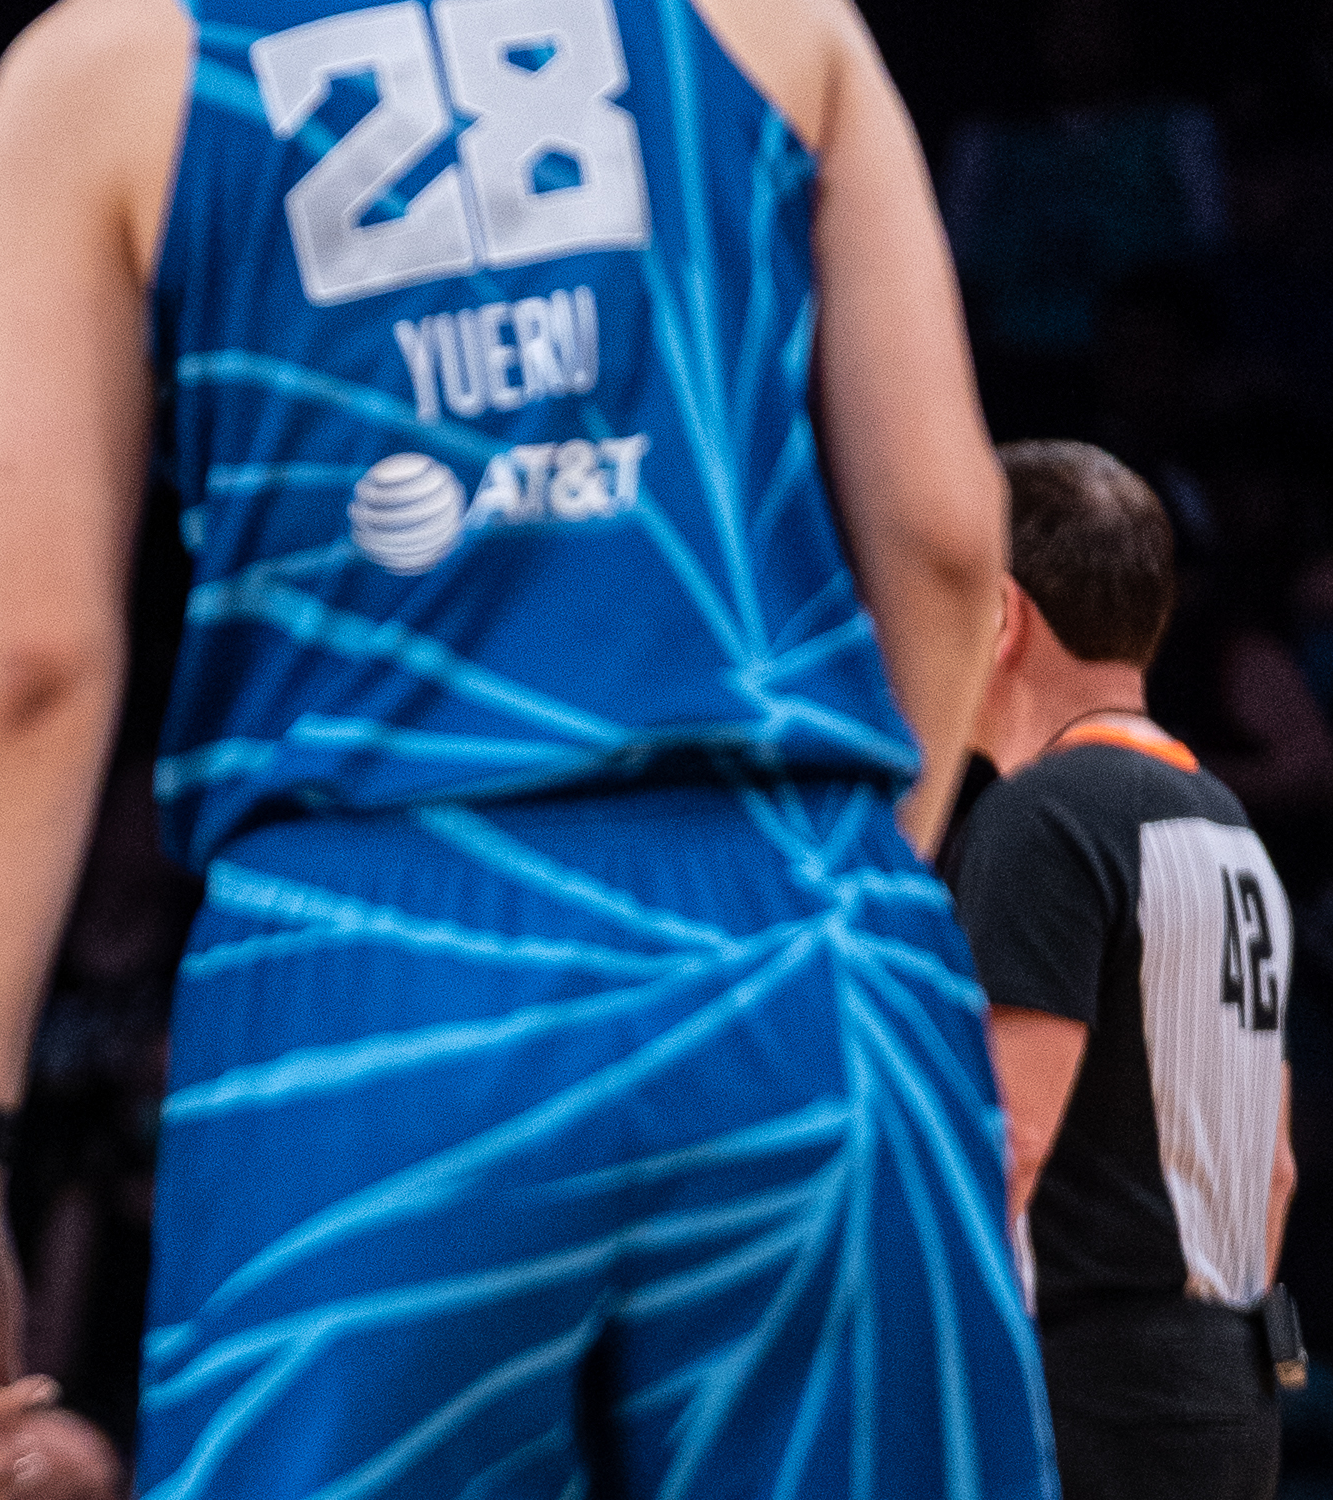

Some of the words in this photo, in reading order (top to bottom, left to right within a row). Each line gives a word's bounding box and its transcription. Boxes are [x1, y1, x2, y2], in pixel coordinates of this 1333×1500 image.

[394, 285, 600, 426] YUERU
[461, 432, 651, 528] AT&T
[1219, 863, 1279, 1032] 42
